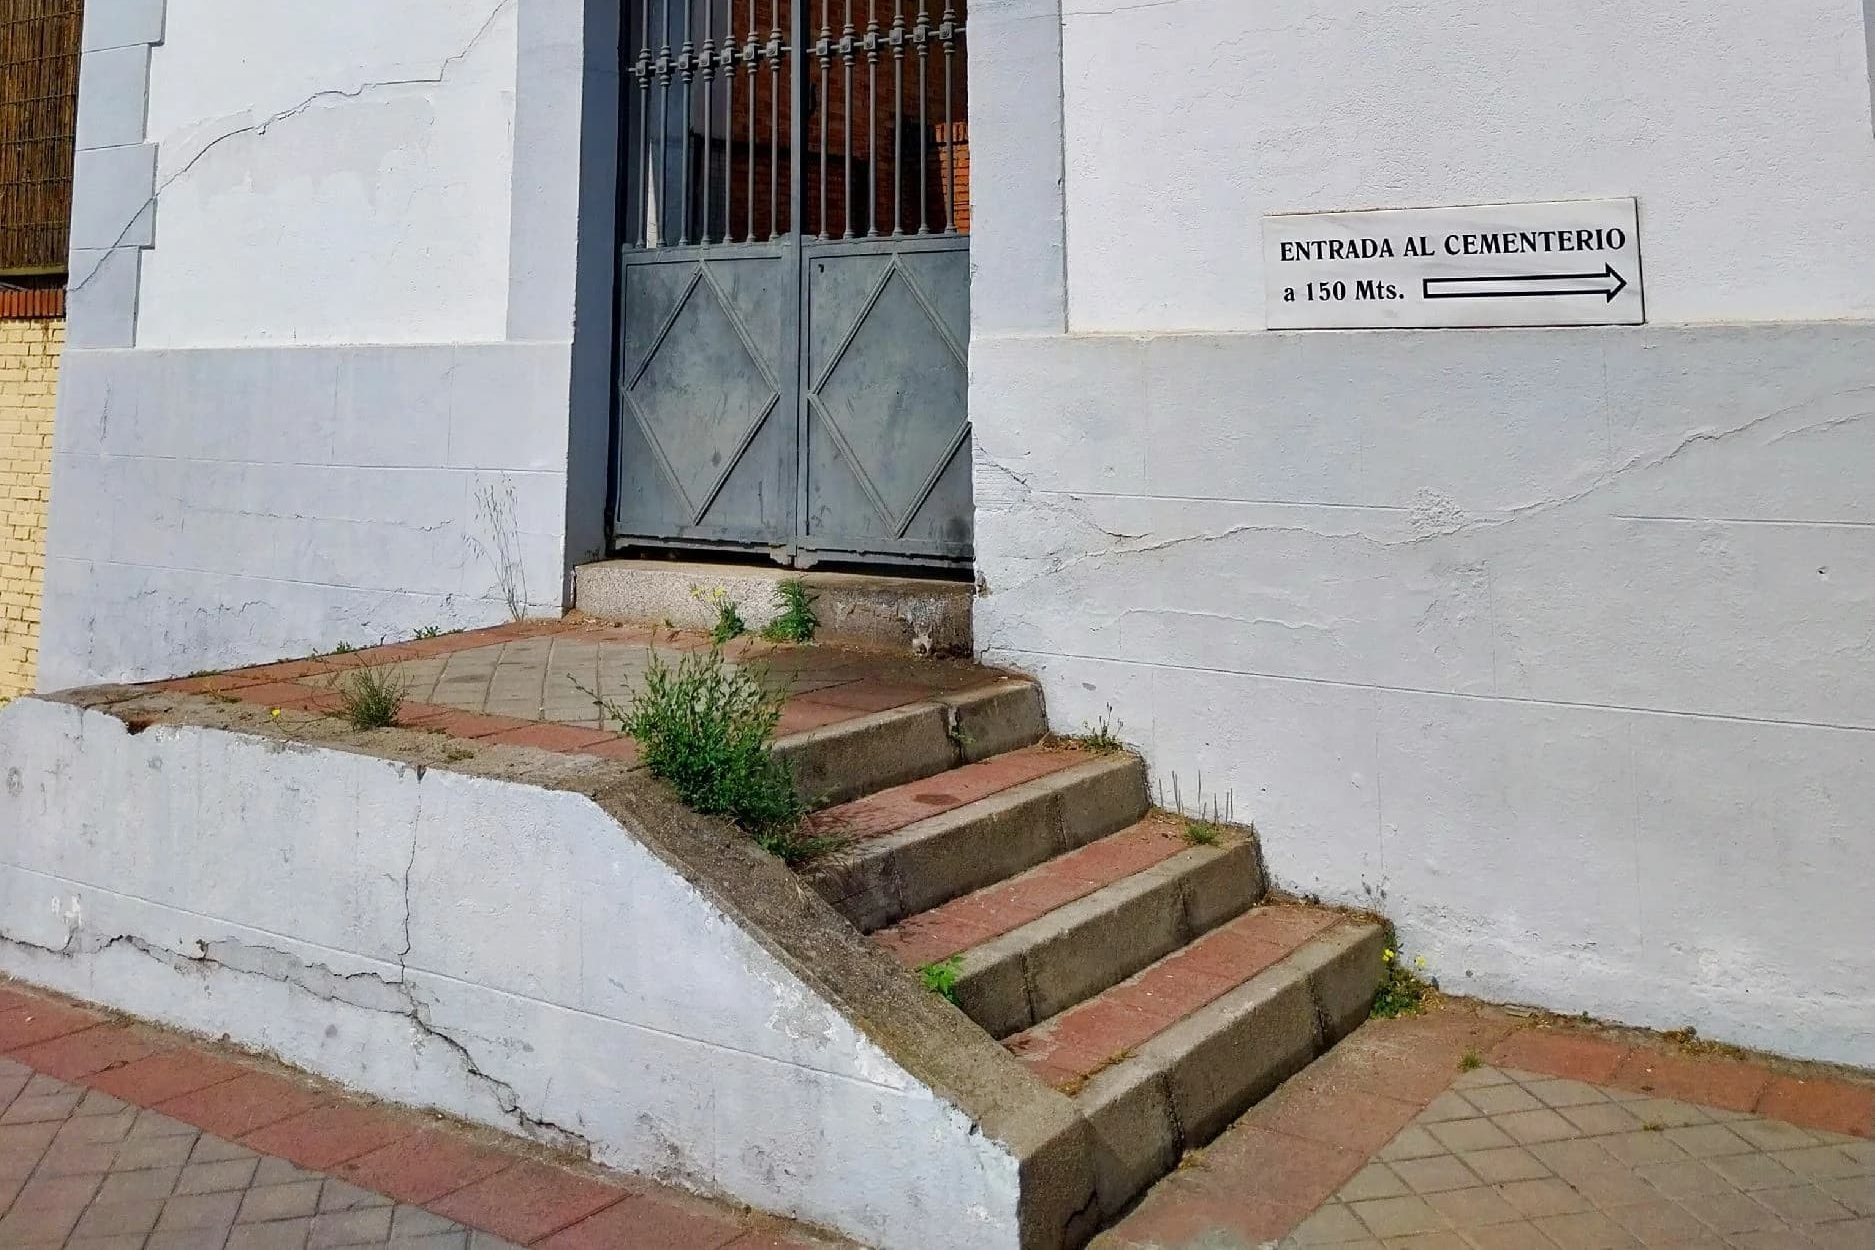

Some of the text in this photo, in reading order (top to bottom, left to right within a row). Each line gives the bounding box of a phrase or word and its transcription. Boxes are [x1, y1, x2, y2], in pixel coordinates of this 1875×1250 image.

[1280, 228, 1626, 261] ENTRADA AL CEMENTERIO
[1283, 280, 1405, 302] a 150 Mts.
